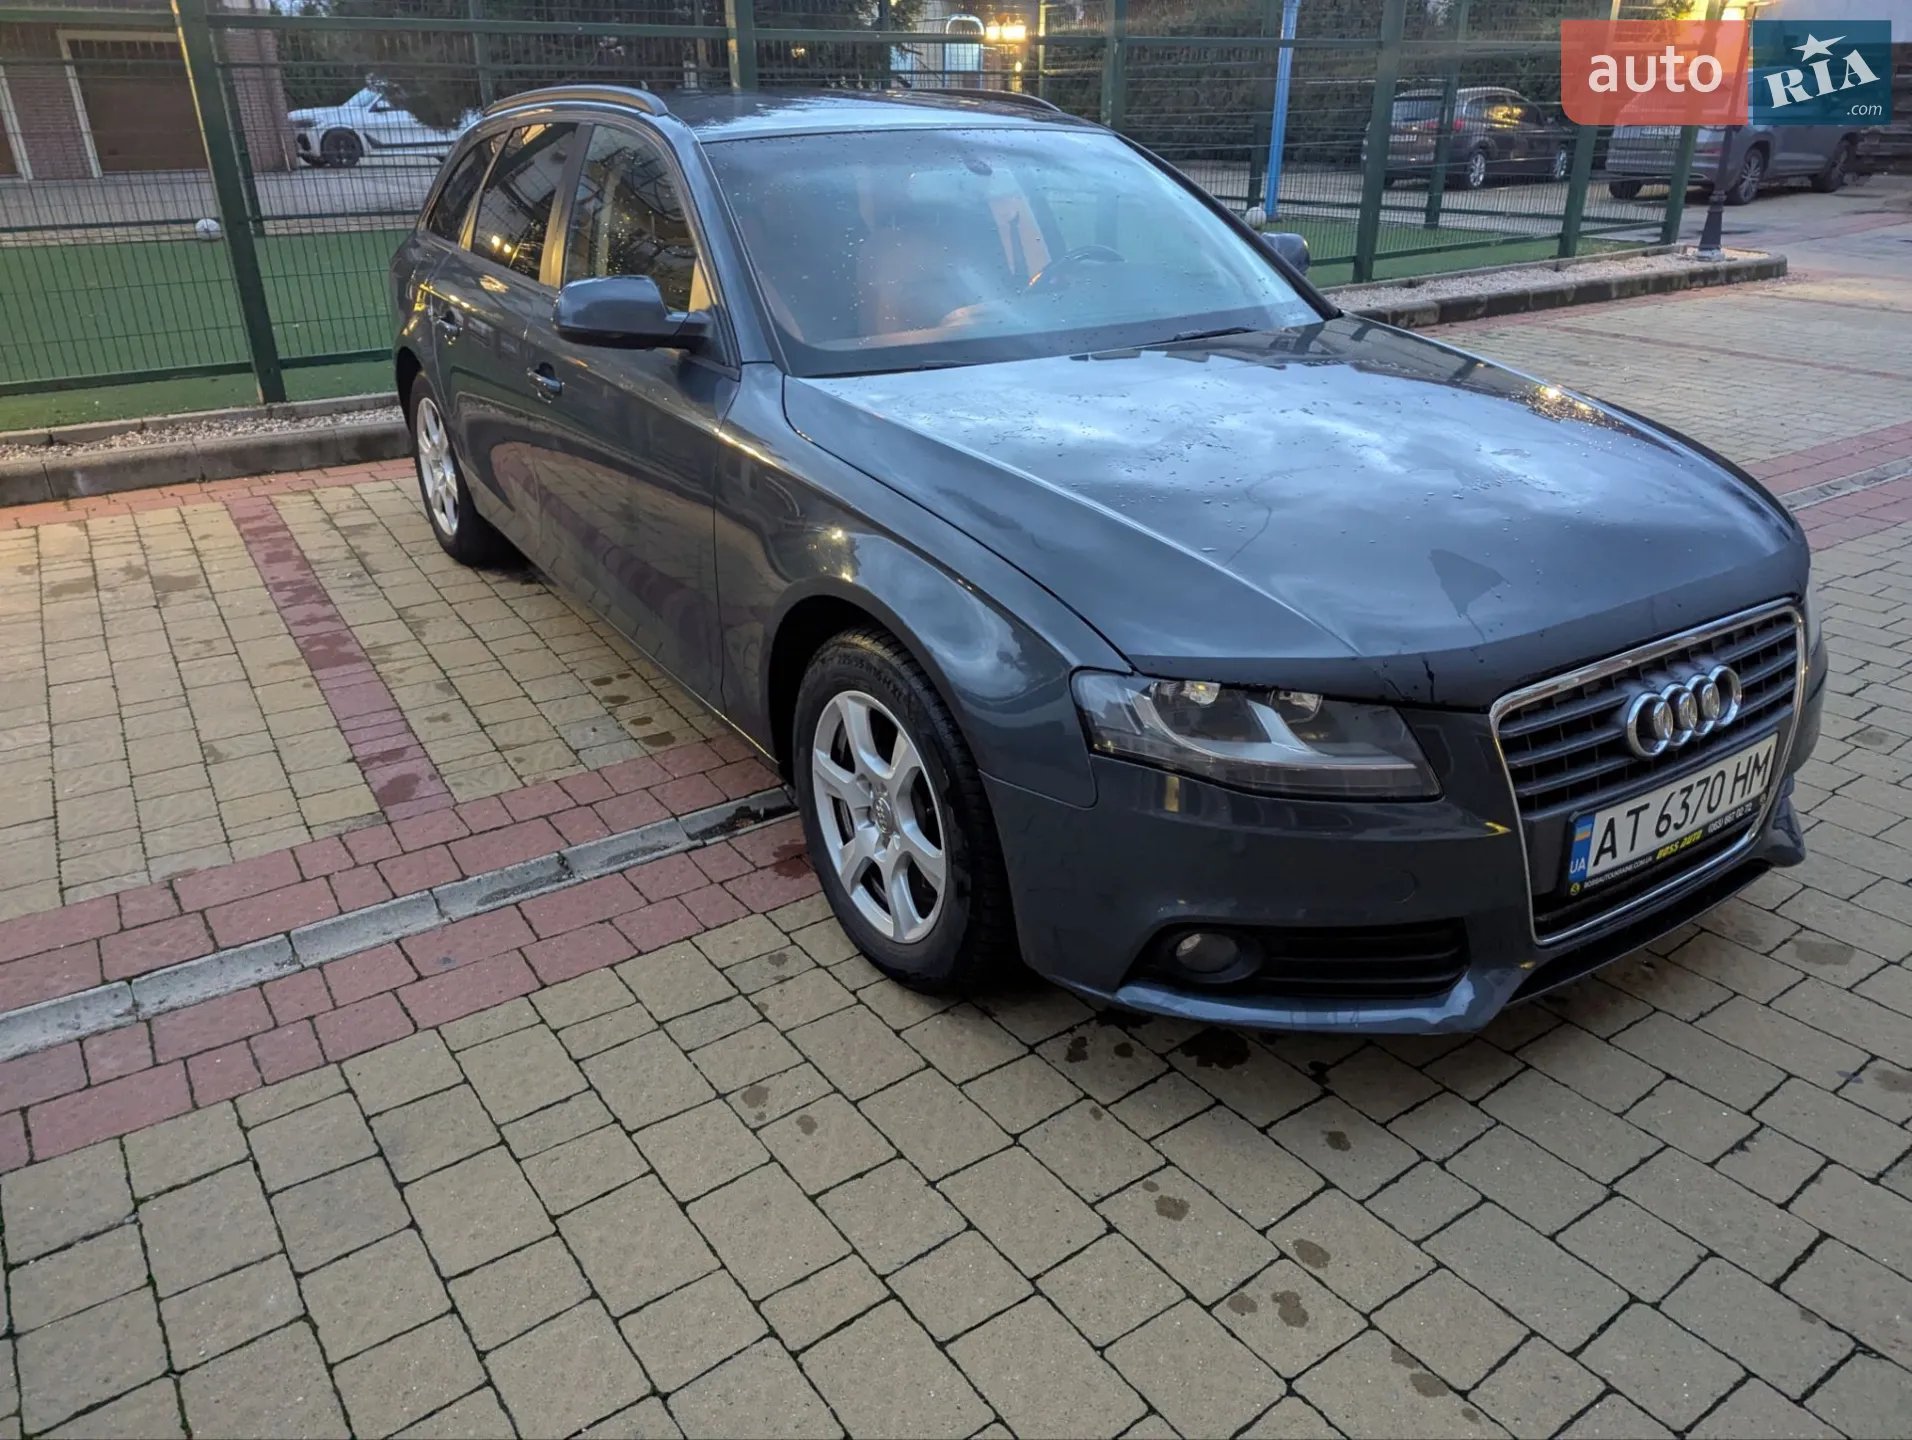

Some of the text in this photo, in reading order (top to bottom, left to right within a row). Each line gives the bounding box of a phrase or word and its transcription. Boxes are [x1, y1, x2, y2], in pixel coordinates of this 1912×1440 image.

[1593, 745, 1772, 867] AT 6370 HM
[1569, 857, 1586, 874] UA
